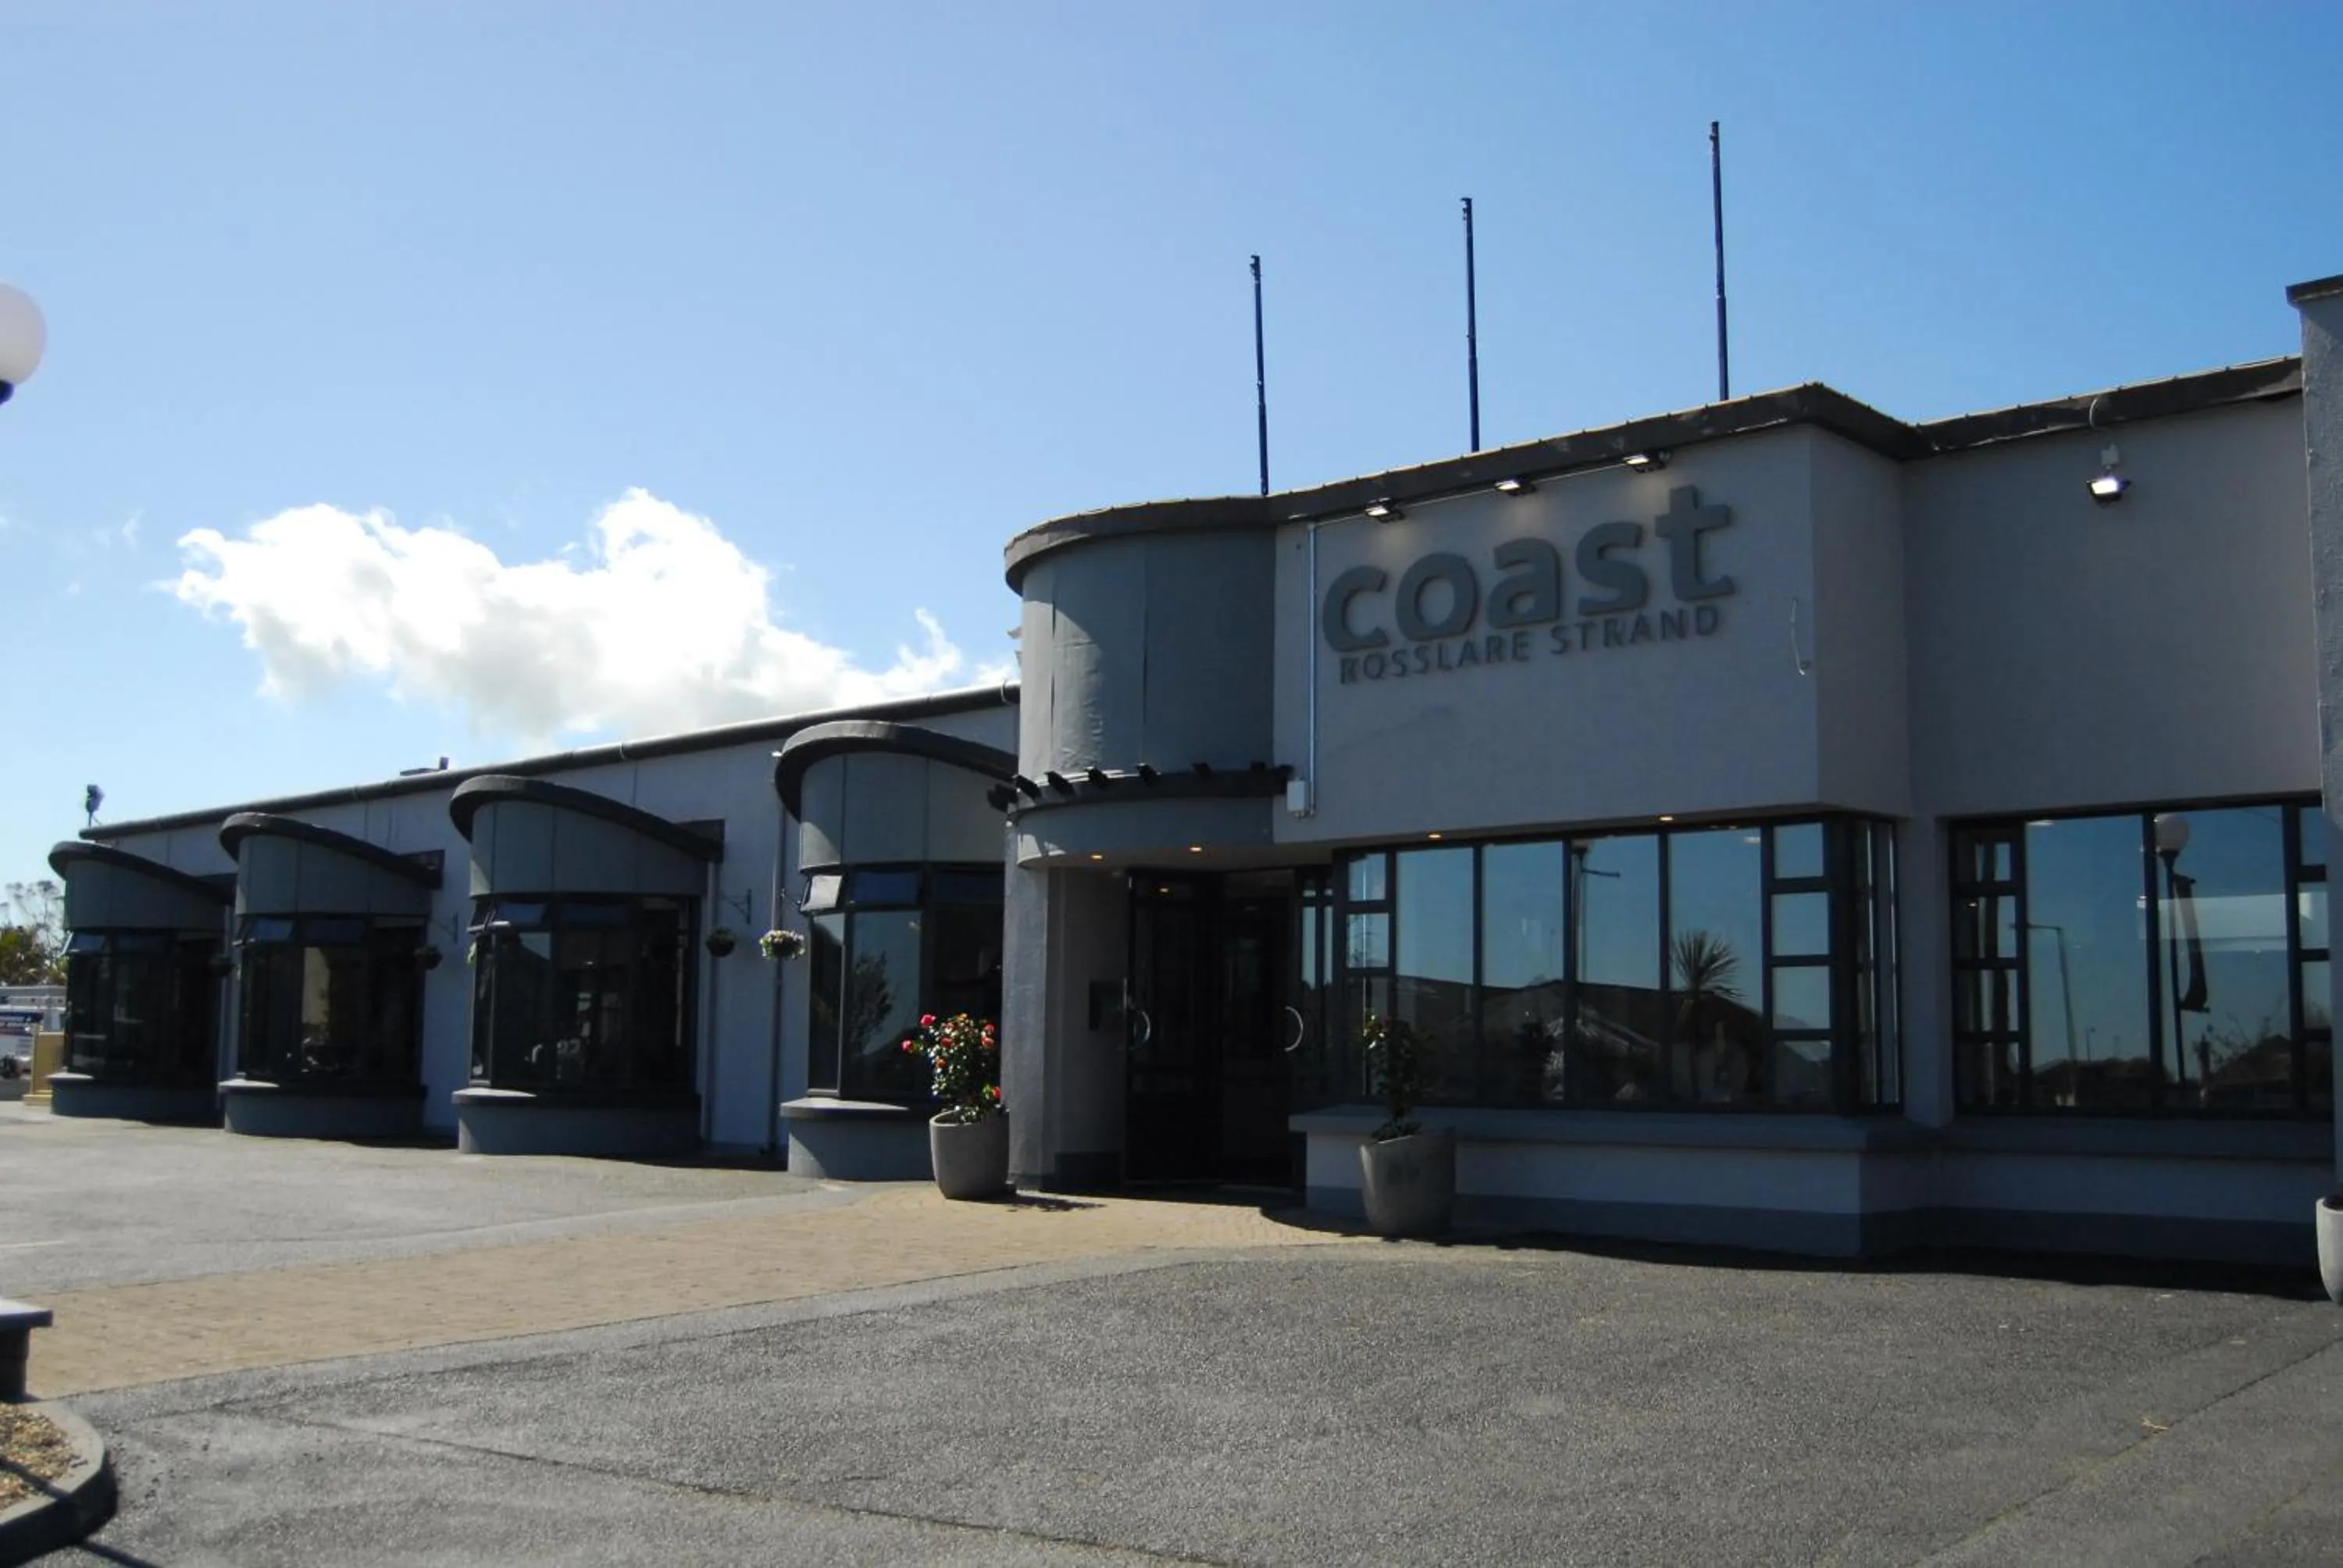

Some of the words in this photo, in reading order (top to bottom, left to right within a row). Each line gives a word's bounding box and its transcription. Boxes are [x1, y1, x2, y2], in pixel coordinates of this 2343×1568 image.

[1324, 484, 1735, 653] coast
[1339, 630, 1530, 685] ROSSLARE
[1550, 605, 1720, 654] STRAND
